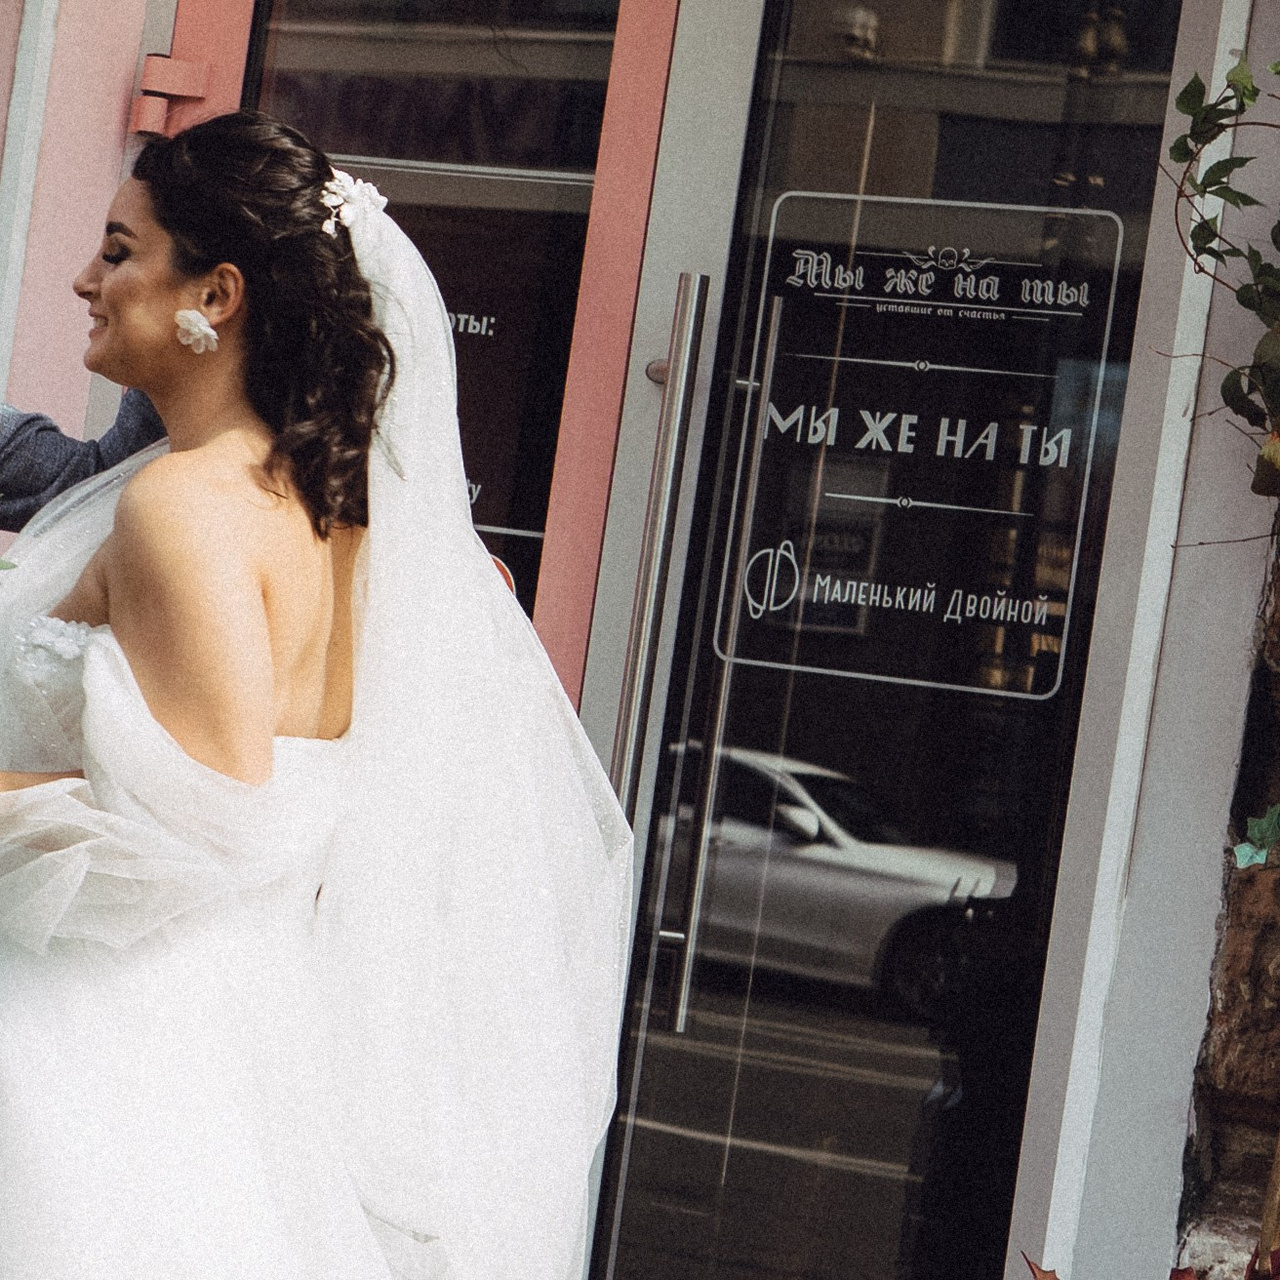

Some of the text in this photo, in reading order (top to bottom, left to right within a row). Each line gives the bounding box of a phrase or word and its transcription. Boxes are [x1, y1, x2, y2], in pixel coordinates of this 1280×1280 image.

[785, 248, 1090, 308] Мы же на ты
[763, 401, 1072, 468] МЫ ЖЕ НА ТЫ
